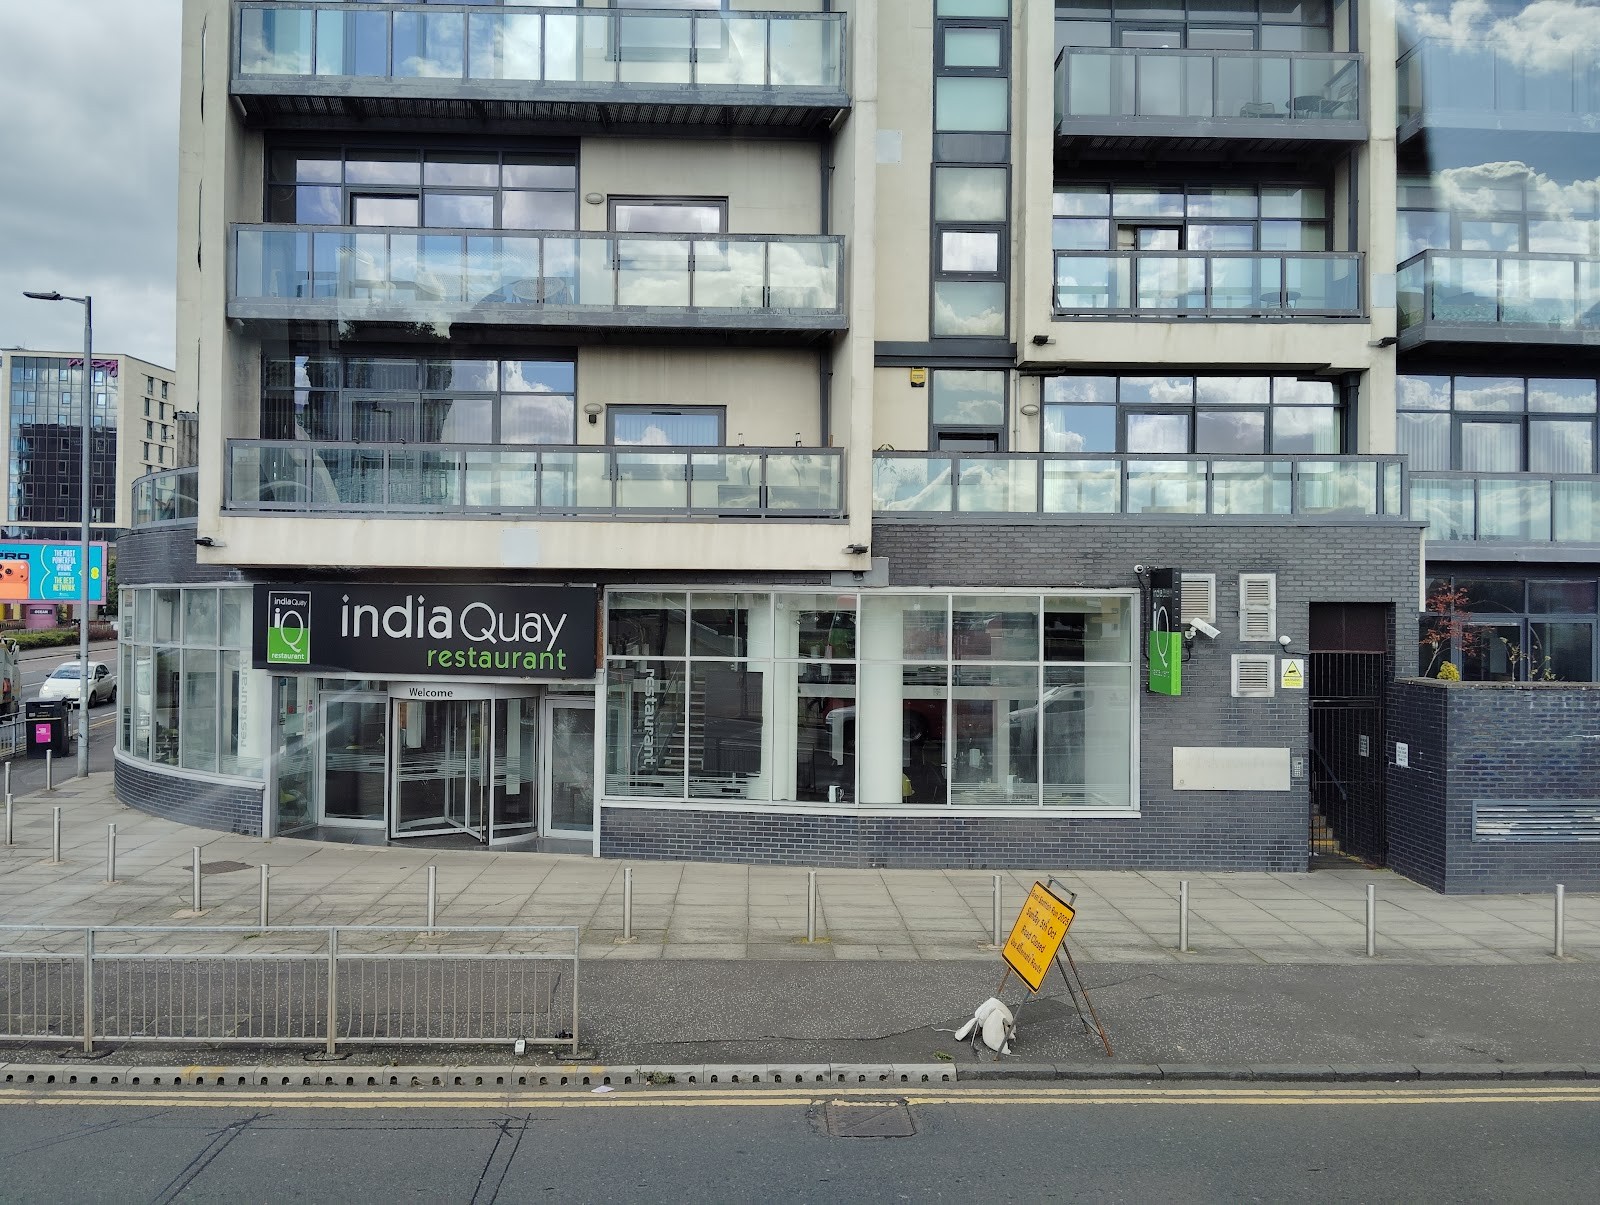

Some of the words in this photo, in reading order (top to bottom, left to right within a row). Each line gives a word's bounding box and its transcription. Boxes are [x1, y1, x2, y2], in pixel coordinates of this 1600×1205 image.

[274, 597, 292, 606] india
[291, 598, 308, 608] Quay
[274, 607, 304, 654] iQ
[341, 594, 453, 639] india
[460, 601, 568, 652] Quay
[271, 652, 305, 660] restaurant
[426, 647, 568, 671] restaurant
[240, 659, 248, 748] restaurant
[408, 687, 454, 698] Welcome
[643, 668, 658, 766] restaurant
[1026, 907, 1040, 926] Sunday
[1047, 925, 1058, 940] Oct
[1058, 912, 1070, 926] 2025
[1021, 924, 1032, 940] Road
[1031, 934, 1047, 953] Closed
